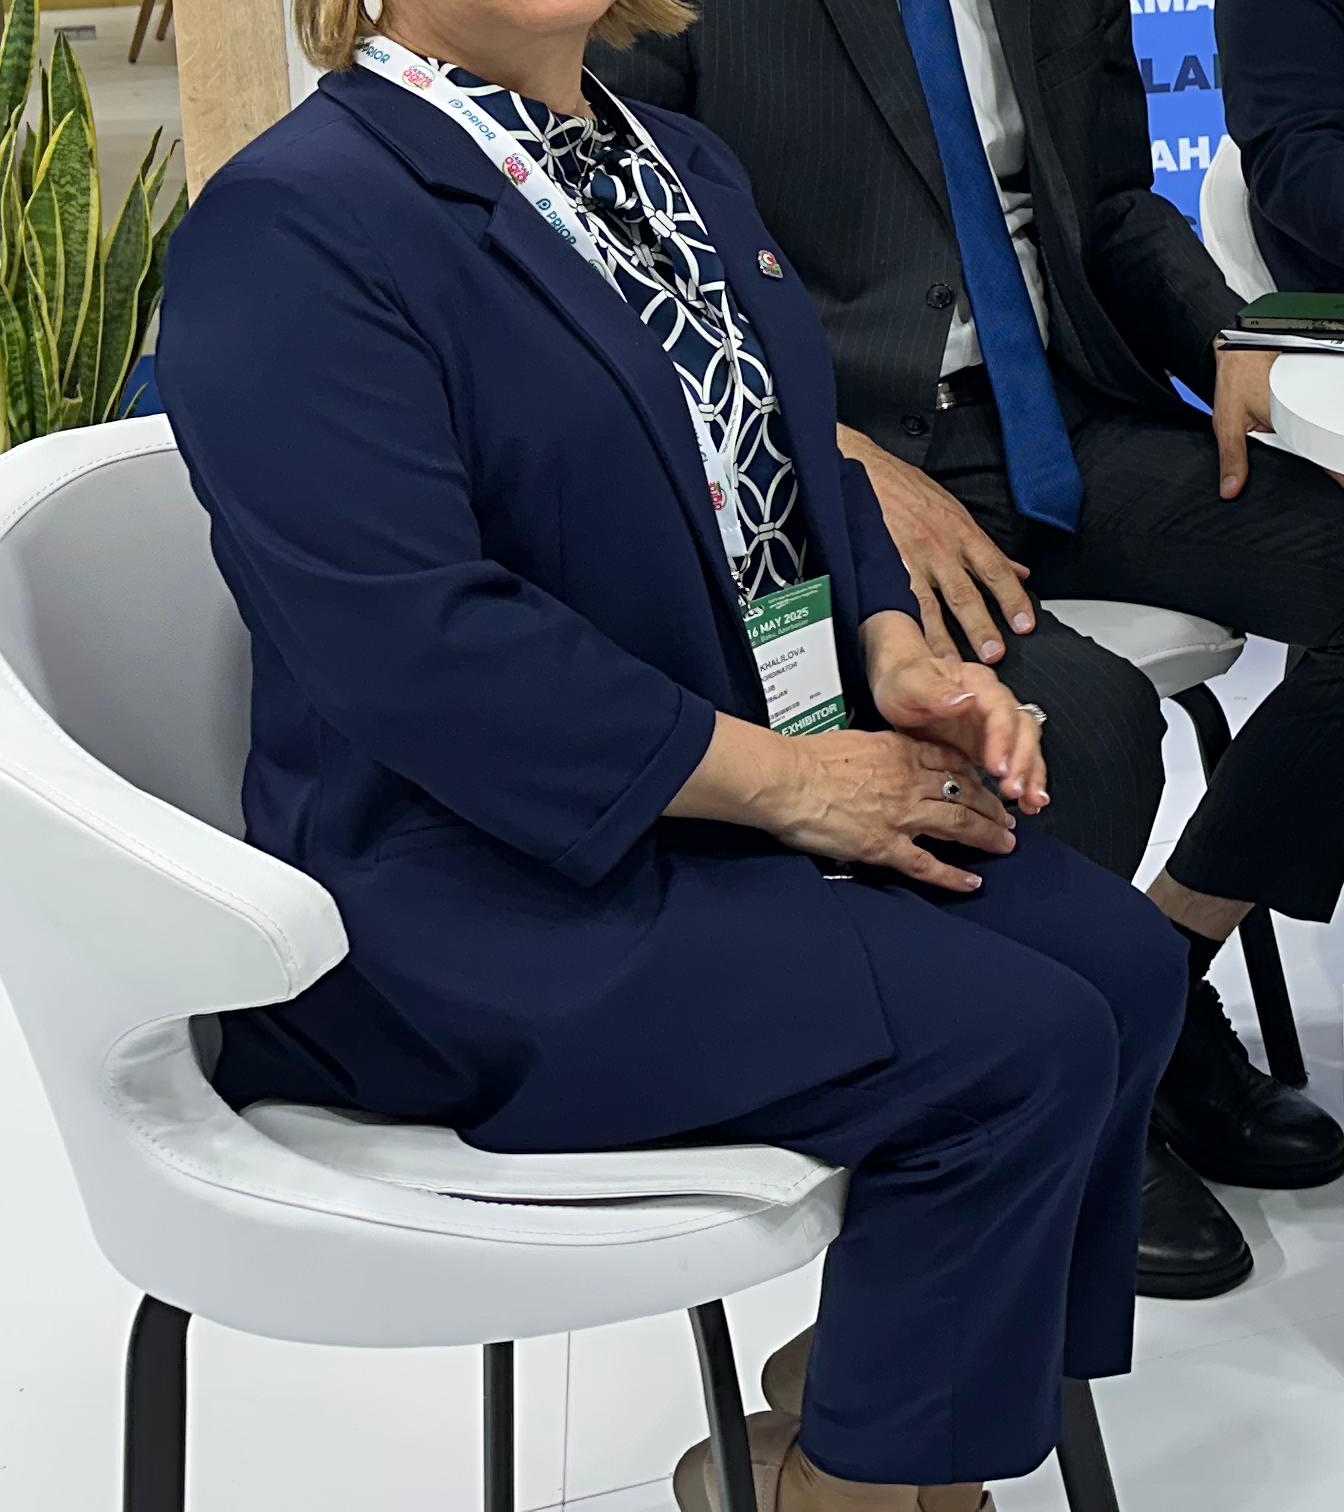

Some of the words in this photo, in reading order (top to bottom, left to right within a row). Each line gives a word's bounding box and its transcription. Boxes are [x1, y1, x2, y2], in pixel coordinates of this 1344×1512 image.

[461, 109, 497, 142] PRIOR
[547, 211, 577, 245] PRIOR
[760, 616, 781, 634] MAY
[783, 606, 809, 625] 2025
[782, 703, 838, 737] EXHIBITOR
